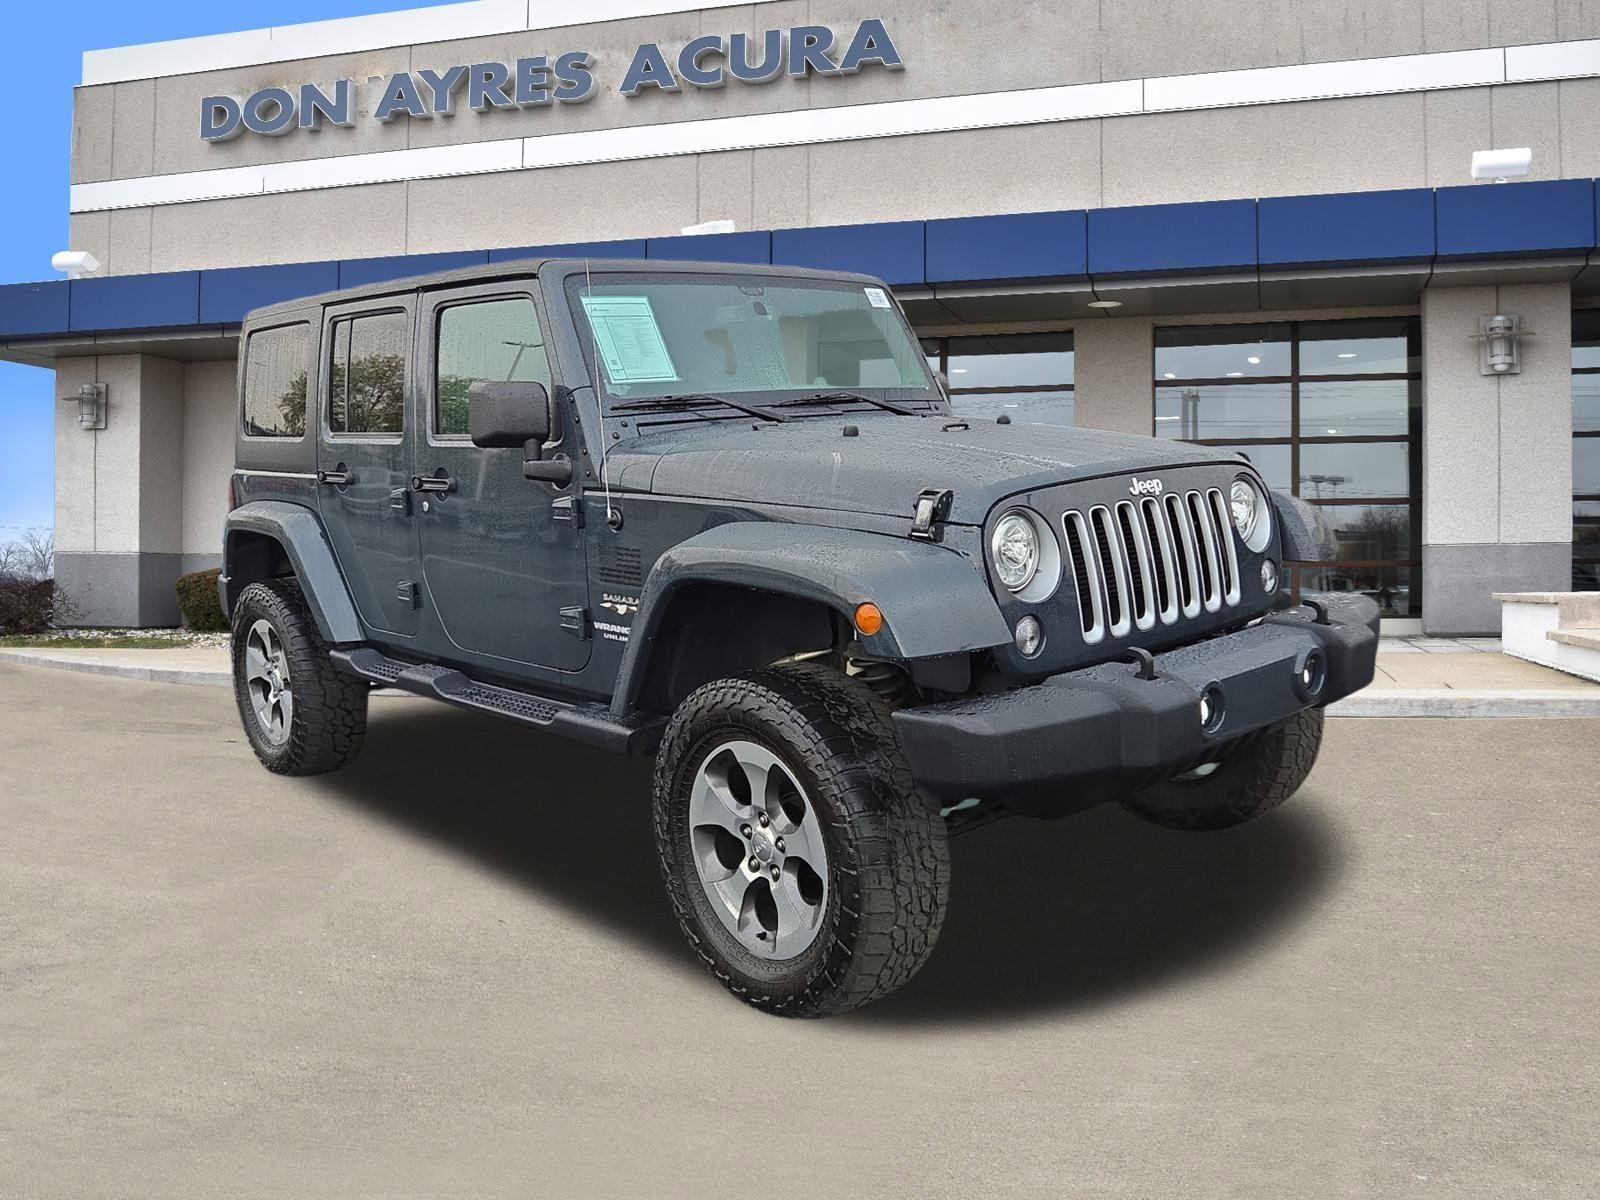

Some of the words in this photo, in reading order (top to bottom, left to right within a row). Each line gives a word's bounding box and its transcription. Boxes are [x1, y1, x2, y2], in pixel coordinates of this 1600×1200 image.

[200, 79, 355, 143] DON
[374, 52, 598, 124] AYRES
[618, 17, 905, 97] ACURA
[1129, 477, 1163, 496] Jeep
[602, 593, 640, 605] SAHARA
